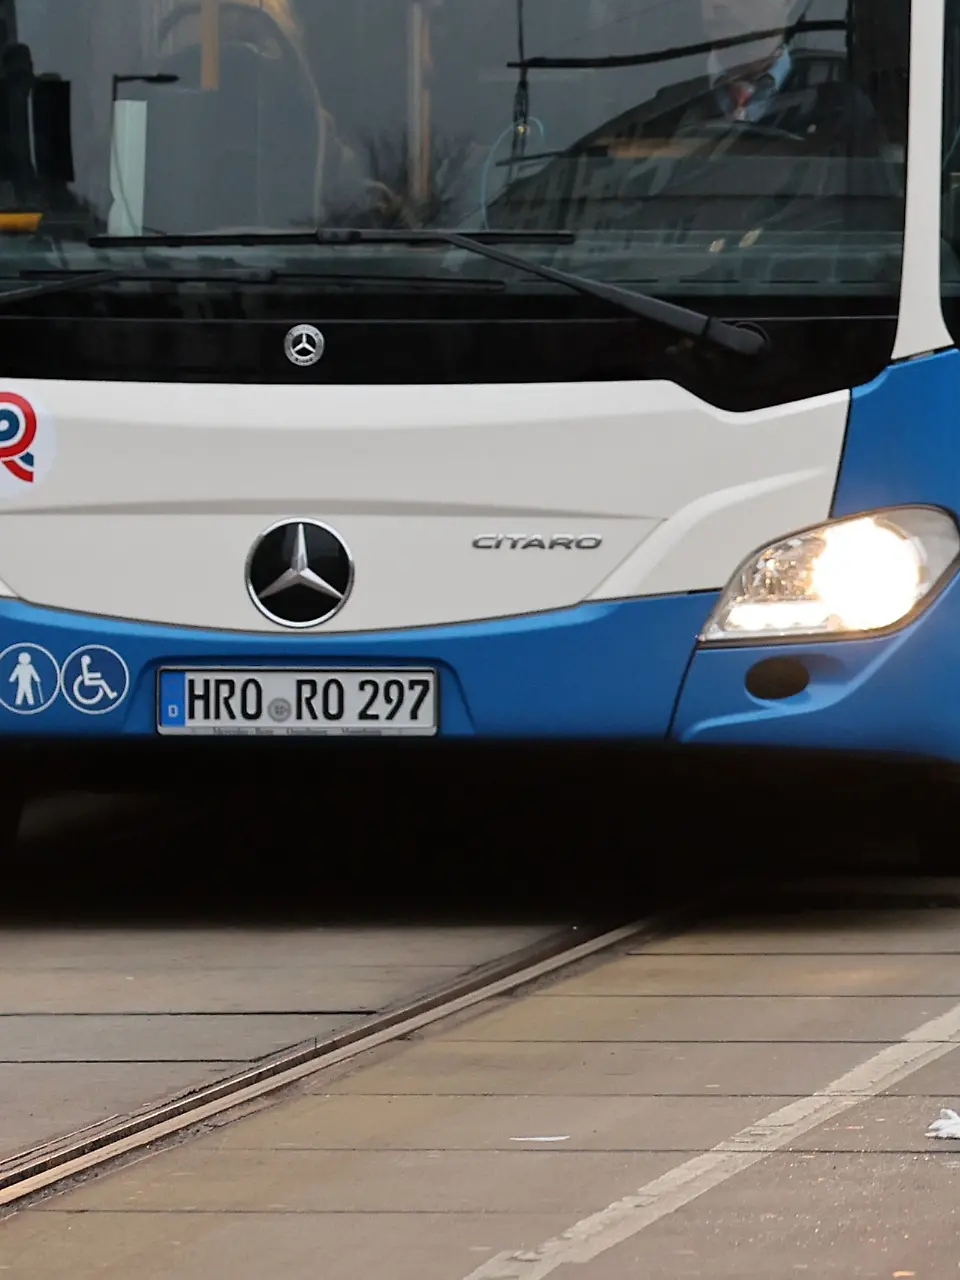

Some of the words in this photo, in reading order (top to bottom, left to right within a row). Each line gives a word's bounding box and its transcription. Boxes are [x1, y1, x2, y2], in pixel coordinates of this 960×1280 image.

[472, 534, 602, 550] CITARO
[188, 678, 263, 721] HRO
[296, 678, 345, 721] RO
[358, 679, 430, 721] 297
